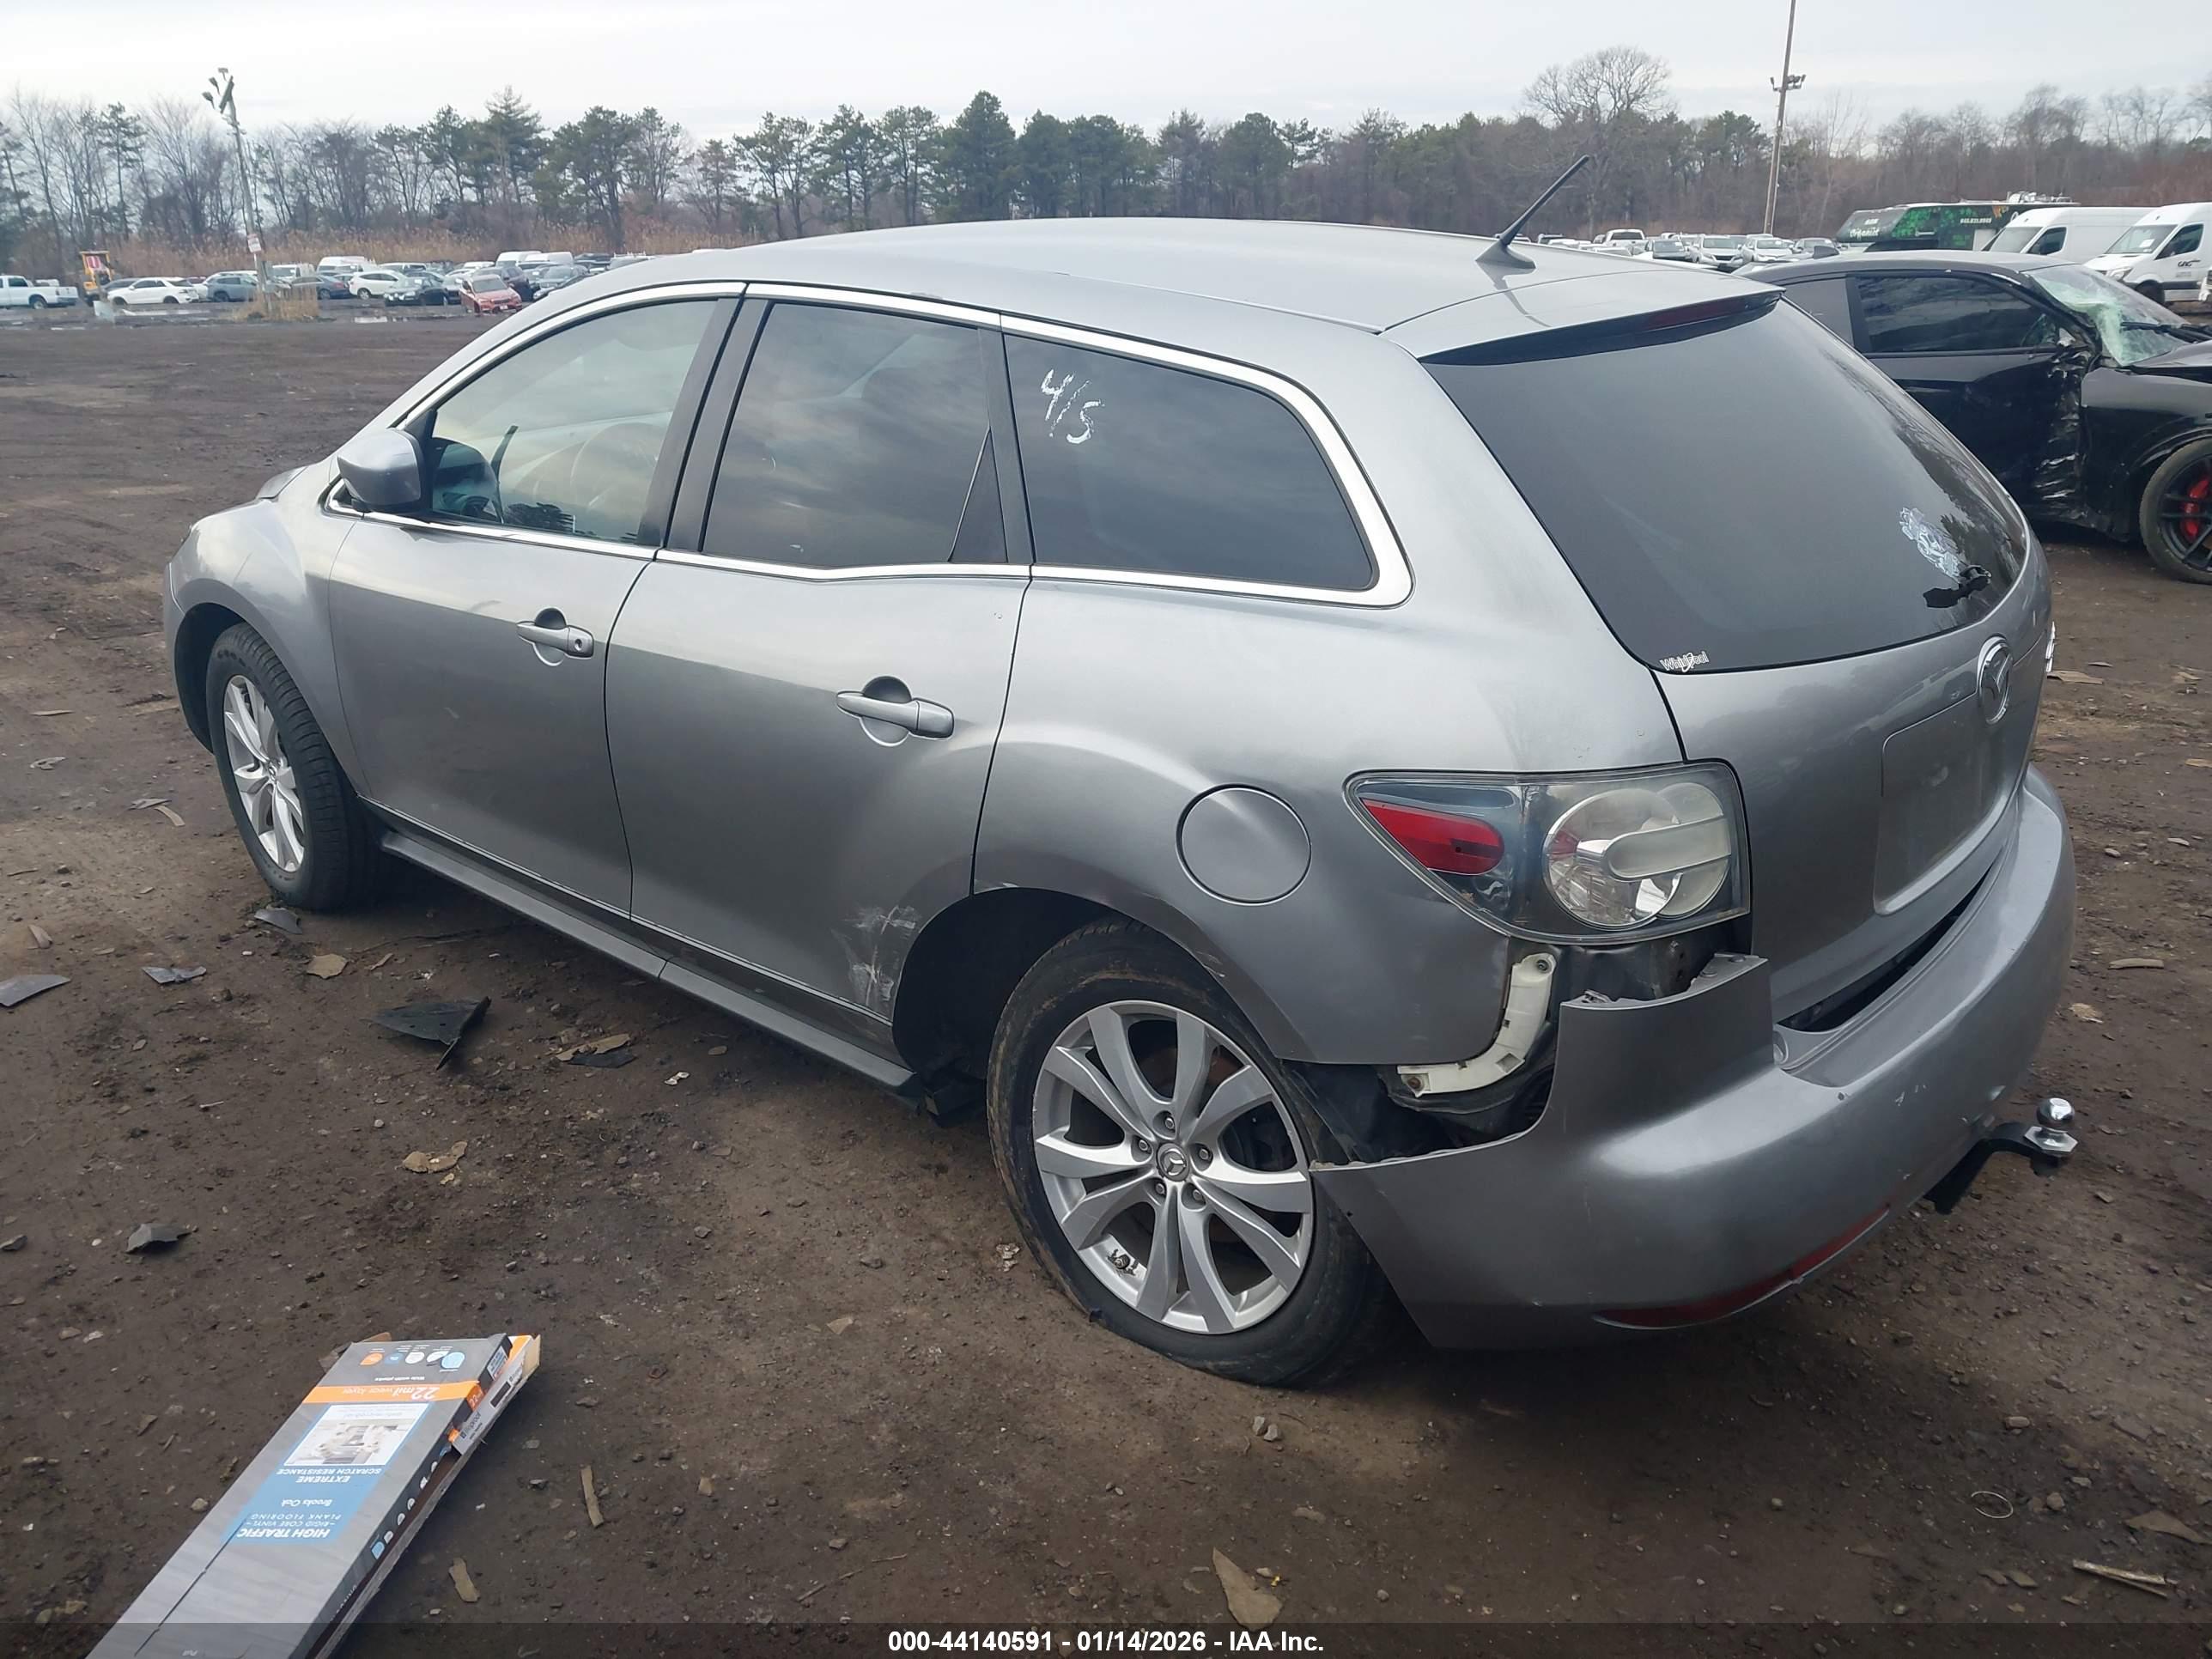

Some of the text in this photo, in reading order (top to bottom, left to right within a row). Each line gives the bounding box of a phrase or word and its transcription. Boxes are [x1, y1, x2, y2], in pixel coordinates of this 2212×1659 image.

[1659, 650, 1710, 672] Whirlpool
[281, 1498, 301, 1507] Oak
[235, 1528, 331, 1538] HIGH TRAFFIC
